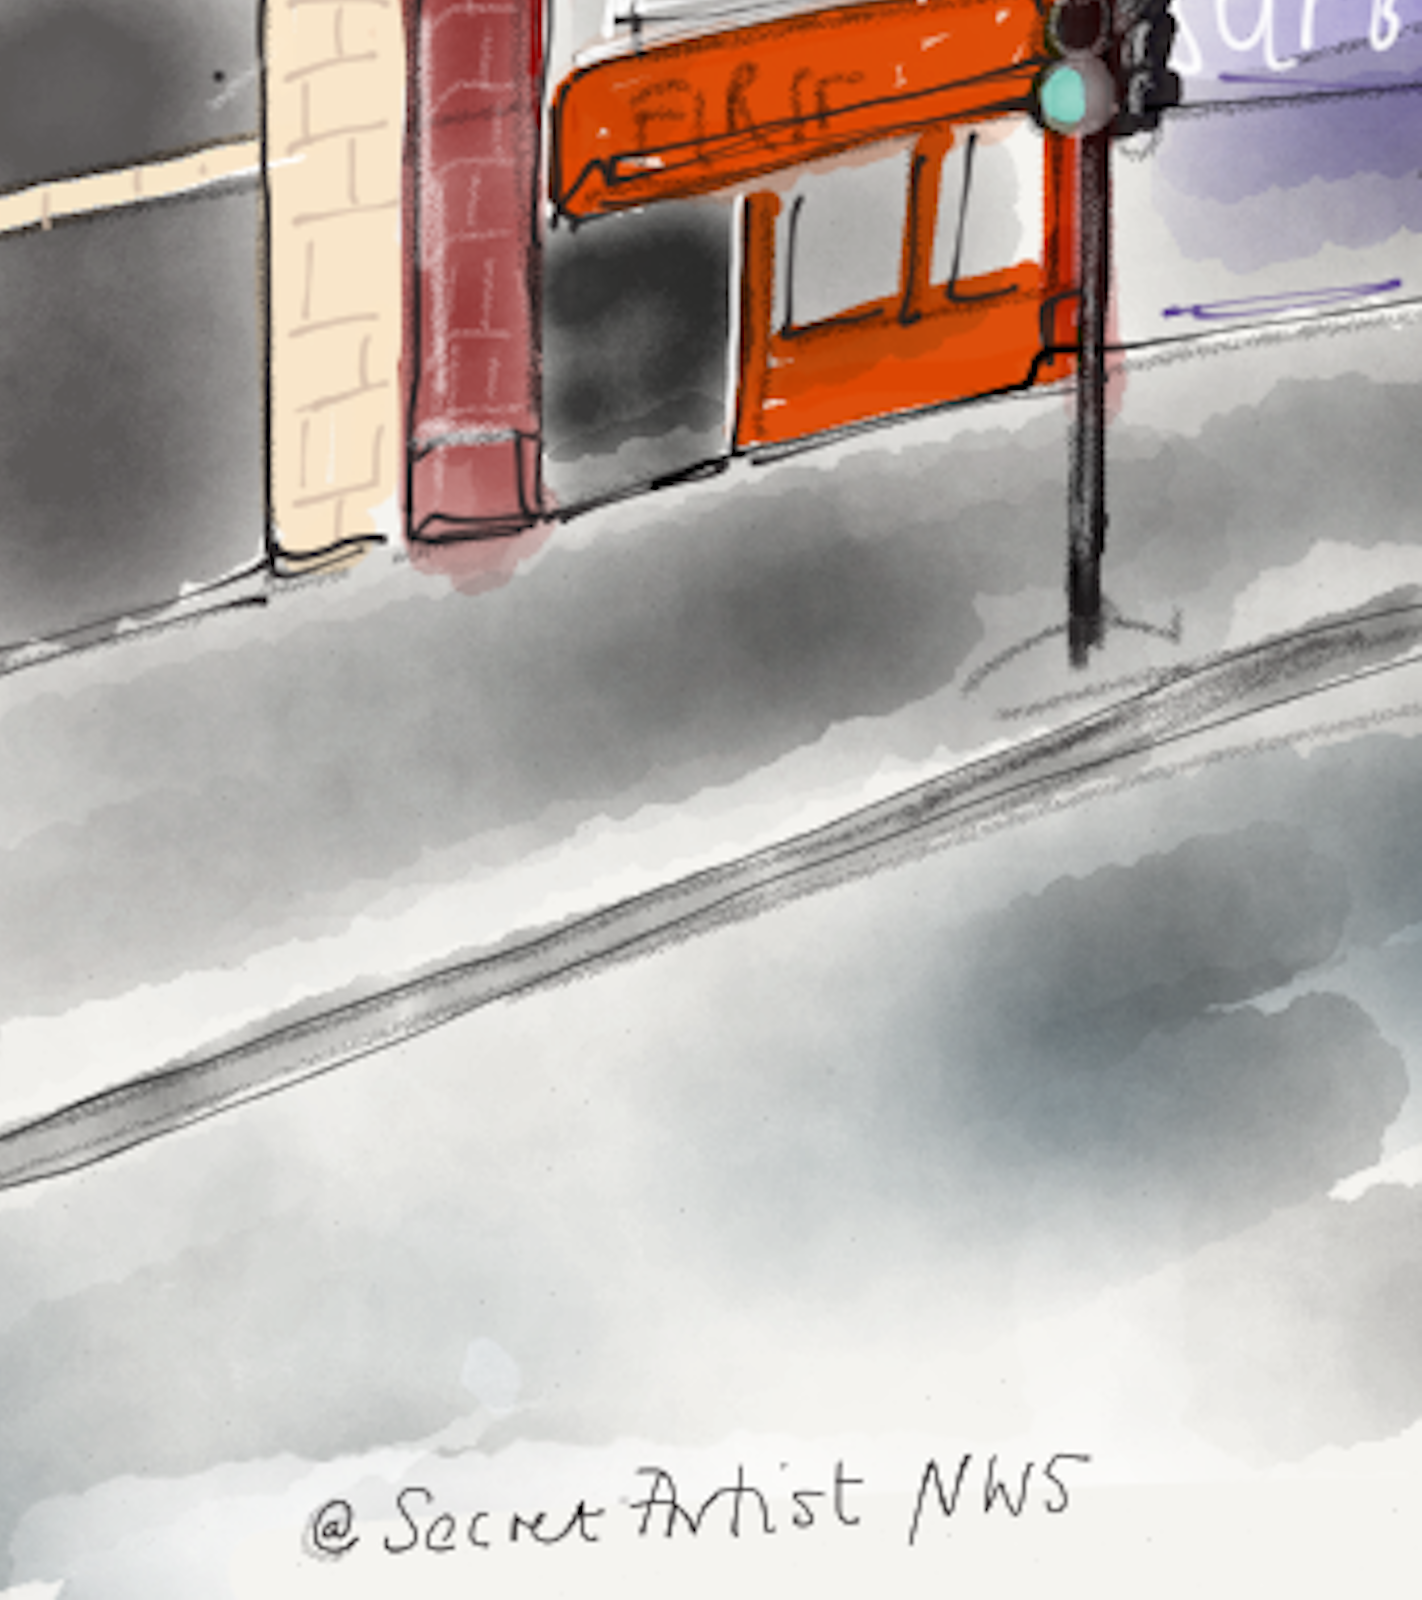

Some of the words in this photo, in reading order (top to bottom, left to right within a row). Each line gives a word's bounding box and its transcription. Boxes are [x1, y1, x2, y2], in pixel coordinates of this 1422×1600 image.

[383, 1486, 605, 1554] Secret
[630, 1461, 864, 1537] Artist
[908, 1453, 1092, 1546] NW5
